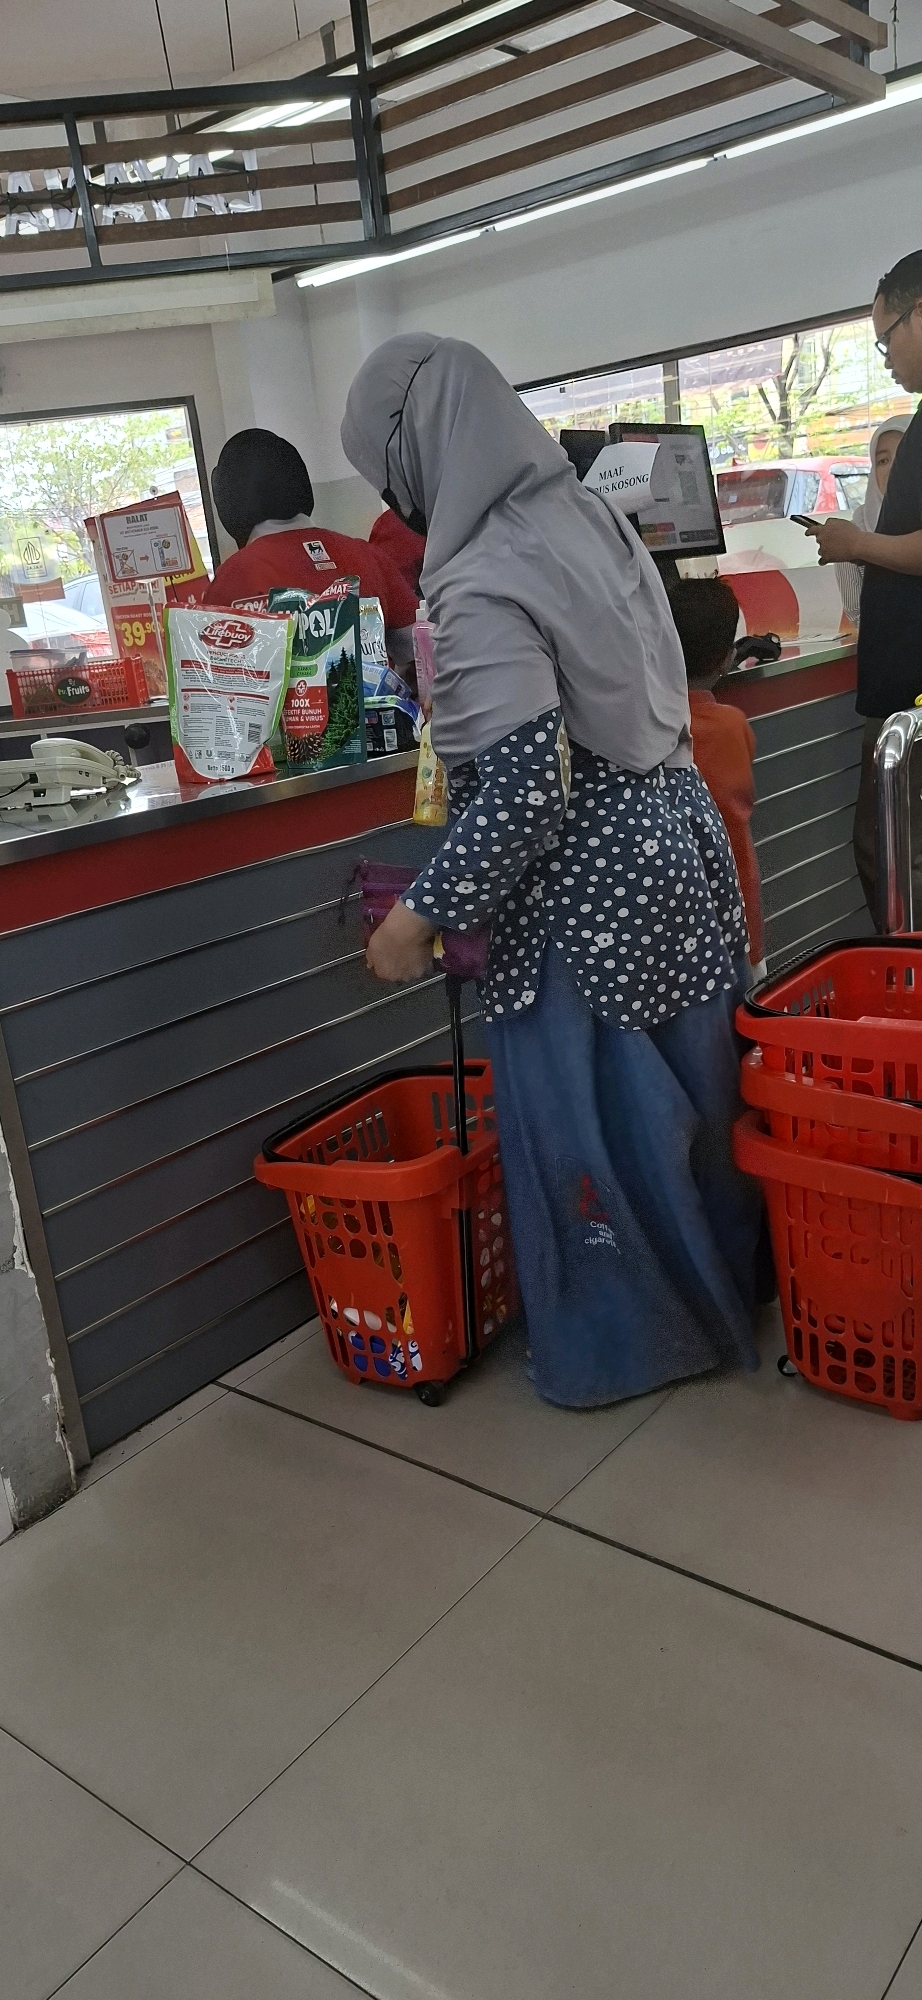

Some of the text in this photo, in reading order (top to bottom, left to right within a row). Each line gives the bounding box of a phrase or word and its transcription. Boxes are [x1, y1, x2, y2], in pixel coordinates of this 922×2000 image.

[599, 466, 624, 481] MAAF
[611, 474, 649, 491] KOSONG
[108, 581, 137, 596] SETIAP
[204, 627, 252, 642] Lifebuoy
[291, 699, 310, 708] 100X
